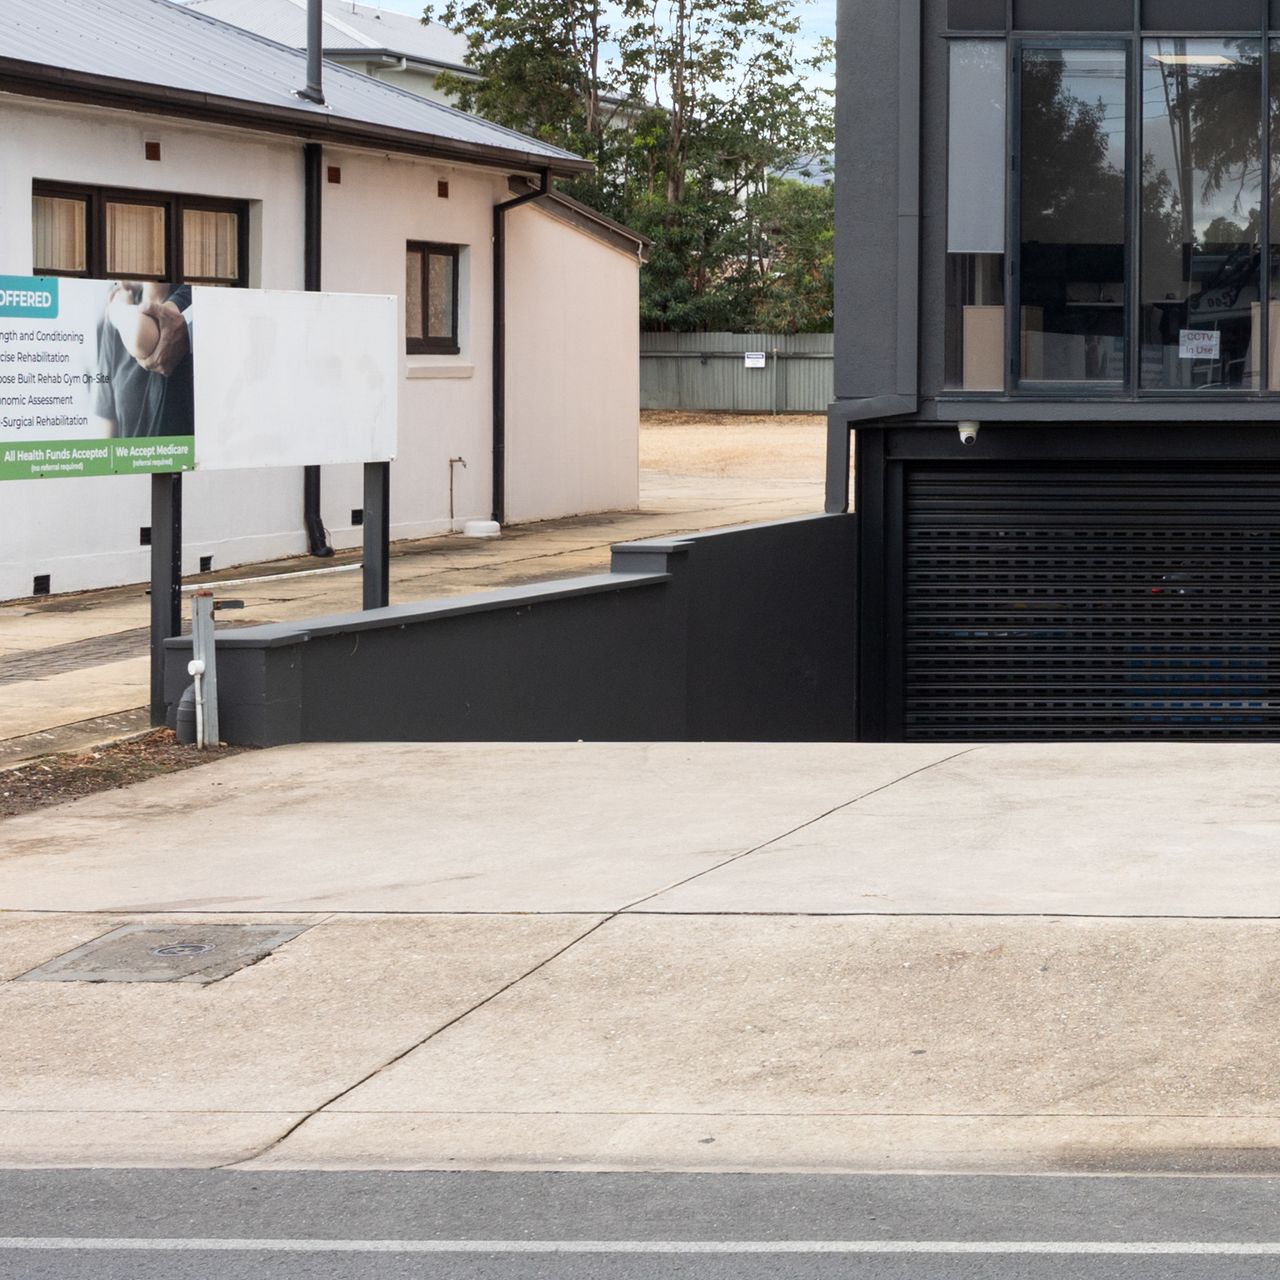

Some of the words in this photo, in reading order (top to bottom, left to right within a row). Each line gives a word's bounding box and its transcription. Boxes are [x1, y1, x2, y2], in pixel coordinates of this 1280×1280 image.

[19, 331, 36, 341] and
[36, 330, 84, 344] Conditioning
[1187, 332, 1213, 341] CCTV
[1196, 346, 1214, 354] Use
[17, 351, 70, 363] Rehabilitation
[17, 373, 36, 384] Built
[37, 373, 62, 384] Rehab
[63, 373, 81, 386] Gym
[82, 373, 112, 384] On-Site
[28, 394, 73, 405] Assessment
[36, 416, 88, 427] Rehabilitation
[4, 450, 16, 462] All
[17, 449, 45, 461] Health
[46, 448, 71, 460] Funds
[72, 446, 108, 460] Accepted
[115, 446, 129, 457] We
[130, 445, 155, 457] Accept
[156, 443, 189, 455] Medicare
